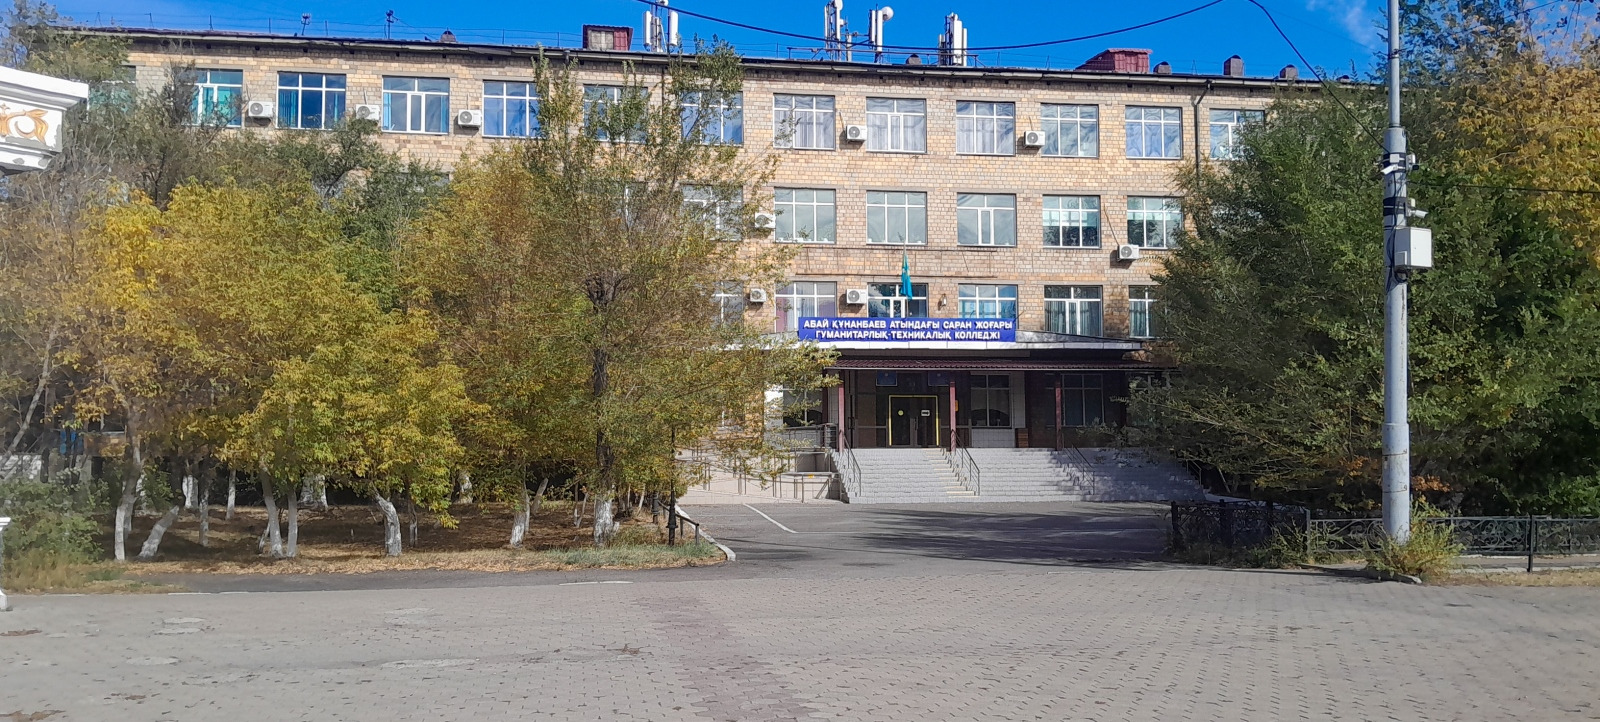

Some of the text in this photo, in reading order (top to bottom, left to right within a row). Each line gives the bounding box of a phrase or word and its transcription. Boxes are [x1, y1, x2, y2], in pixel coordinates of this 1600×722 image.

[804, 318, 1013, 329] АБАЙ ҚҰНАНБАЕВ АТЫНДАҒЫ САРАН ЖОҒАРЫ
[954, 331, 1001, 339] КОЛЛЕДЖІ
